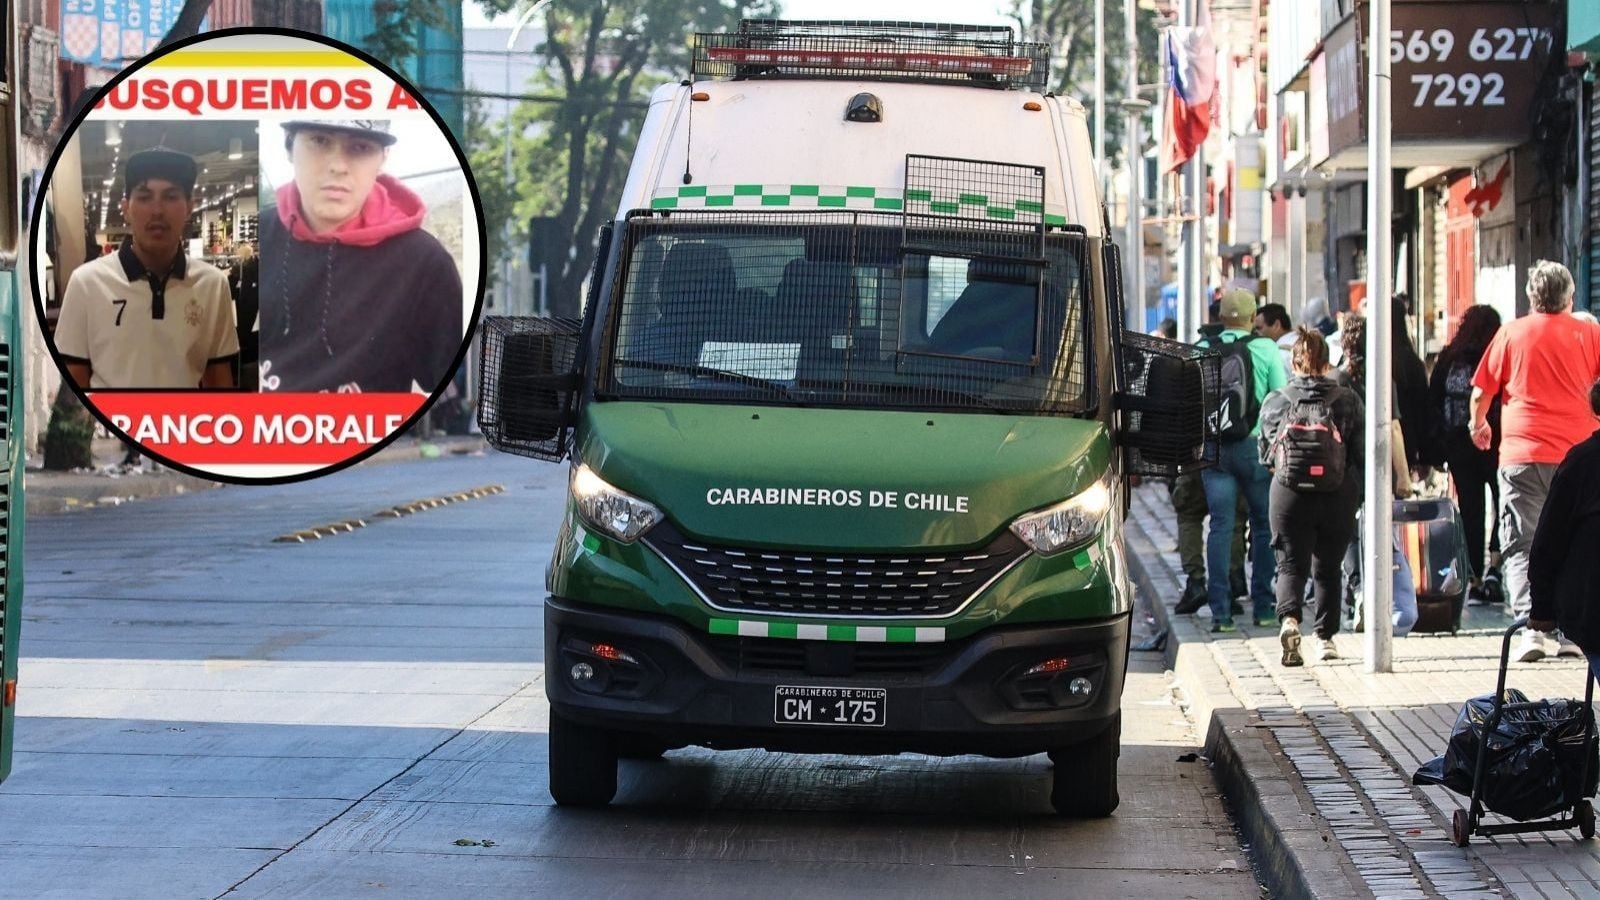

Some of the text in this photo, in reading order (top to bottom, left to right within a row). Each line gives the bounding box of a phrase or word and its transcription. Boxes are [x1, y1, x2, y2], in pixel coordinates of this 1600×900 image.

[1411, 72, 1506, 107] 7292
[112, 299, 127, 327] 7
[706, 488, 969, 513] CARABINEROS DE CHILE
[779, 687, 881, 699] CARABINEROS DE CHILE
[784, 698, 877, 723] CM 175
